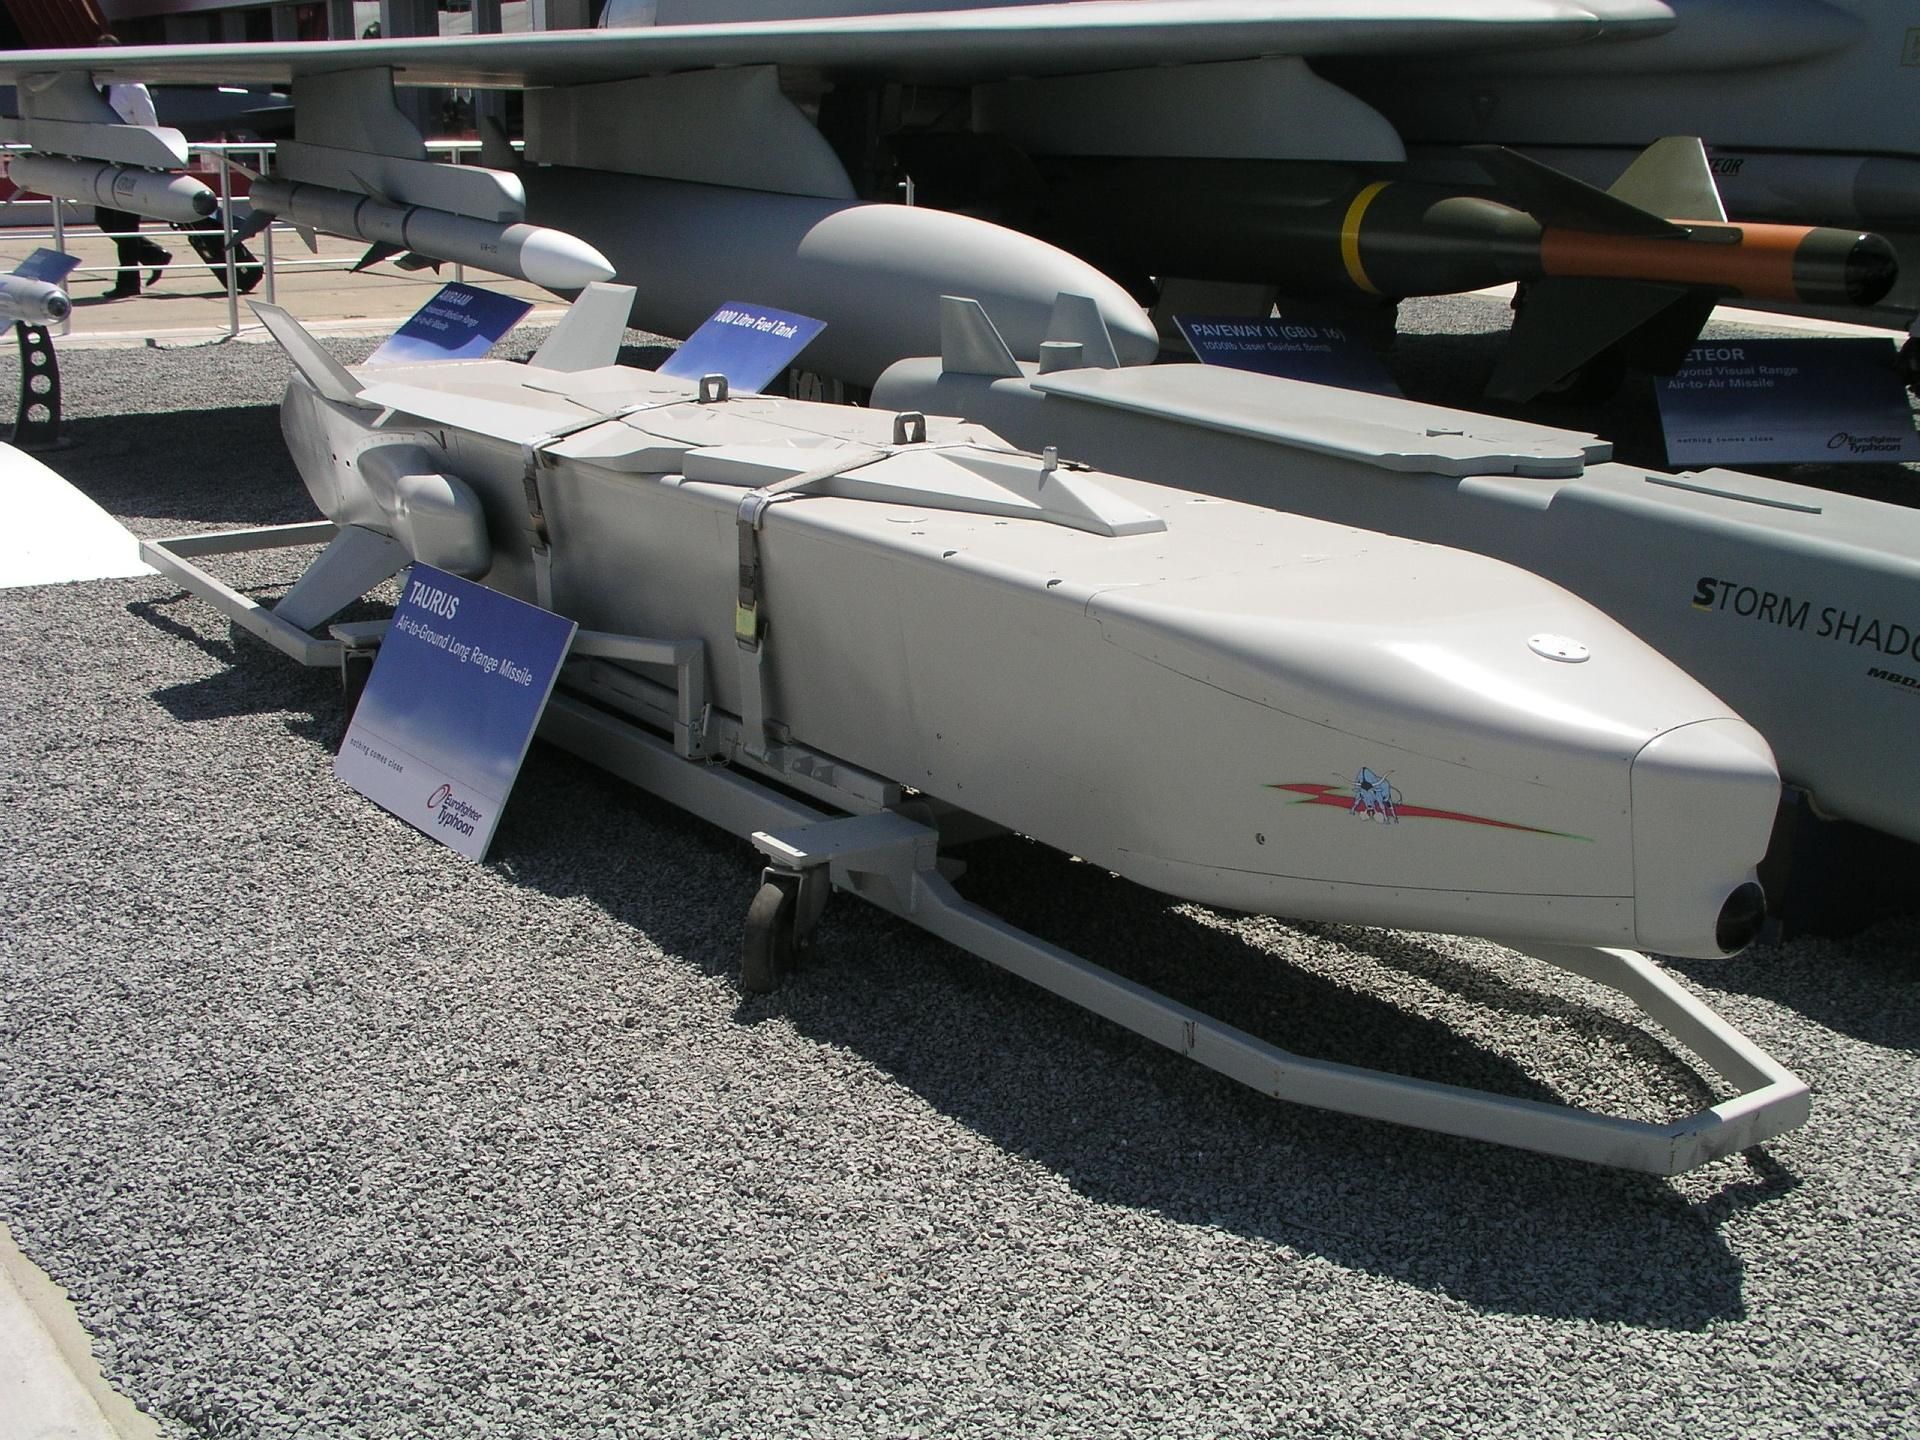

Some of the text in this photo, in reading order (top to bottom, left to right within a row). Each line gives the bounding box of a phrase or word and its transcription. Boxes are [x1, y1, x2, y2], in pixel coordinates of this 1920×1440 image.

[713, 310, 798, 339] 1000 Litre Fuel Tank
[1191, 323, 1265, 338] PAVEWAY
[1265, 325, 1278, 338] II
[1279, 325, 1318, 341] (GBU
[1203, 341, 1332, 353] 1000lb Laser Guided Bomb
[1667, 378, 1775, 390] Air-to-Air Missile
[1715, 365, 1755, 376] Visual
[1759, 365, 1799, 377] Range
[1847, 435, 1902, 444] Eurofighter
[1848, 442, 1902, 453] Typhoon
[408, 580, 460, 620] TAURUS
[1693, 577, 1811, 631] STORM
[396, 614, 533, 687] Air-to-Ground Long Range Missile
[349, 737, 405, 774] nothing comes close
[437, 806, 475, 837] Typhoon
[443, 793, 482, 823] Eurofighter
